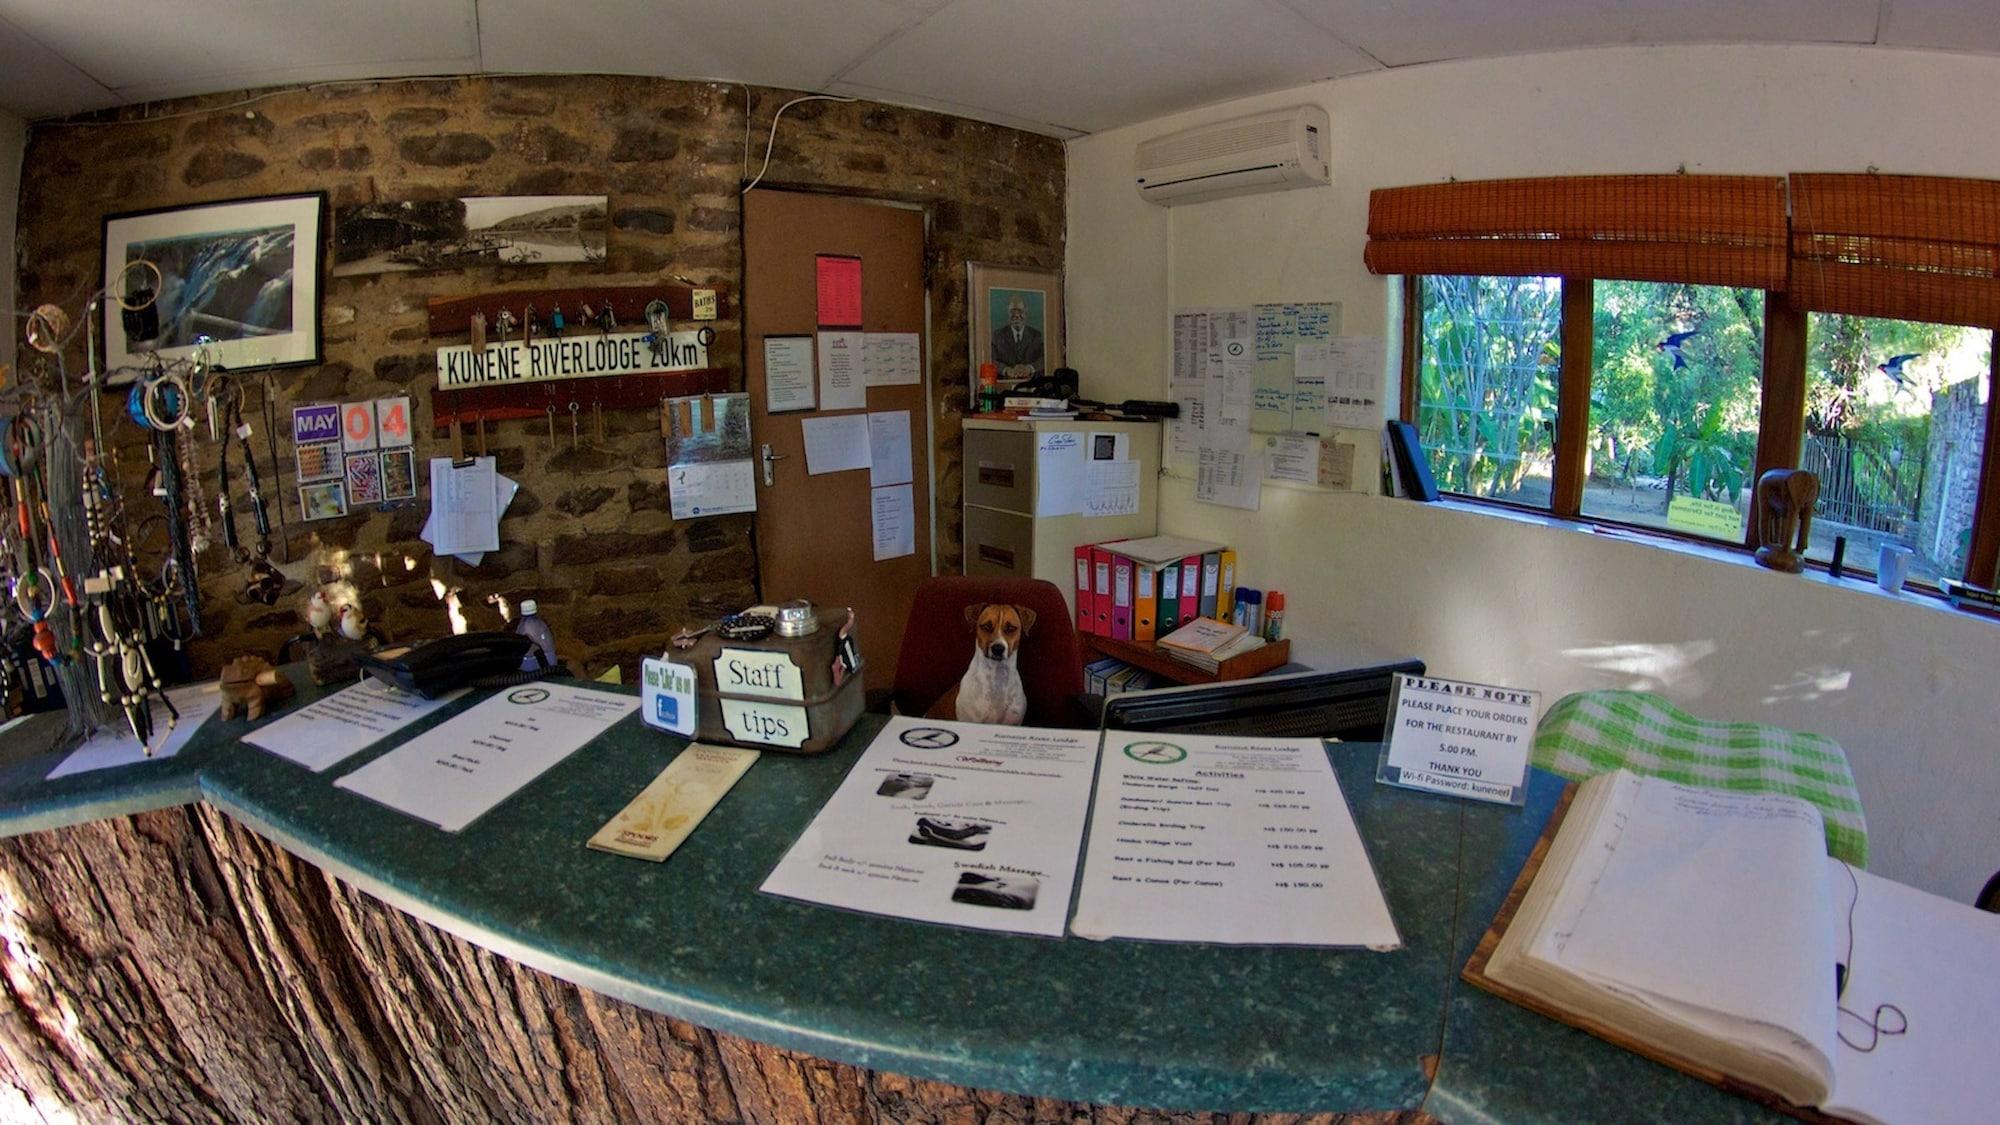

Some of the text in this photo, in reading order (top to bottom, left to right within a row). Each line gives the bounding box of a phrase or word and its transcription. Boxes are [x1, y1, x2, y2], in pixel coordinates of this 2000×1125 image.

[447, 346, 522, 385] KUNENE
[650, 341, 699, 369] 20km
[296, 412, 337, 434] MAY
[645, 663, 659, 688] Please
[676, 675, 683, 693] us
[683, 677, 692, 695] on
[728, 658, 786, 690] Staff
[1405, 677, 1532, 705] PLEASE NOTE
[1401, 698, 1528, 726] PLEASE PLACE YOUR ORDERS
[740, 709, 790, 741] tips
[1405, 718, 1518, 744] FOR THE RESTAURANT BY
[1439, 743, 1459, 754] 5.00
[1195, 770, 1245, 779] Activities
[1425, 772, 1470, 791] Password:
[1429, 761, 1482, 778] THANK YOU
[953, 861, 996, 871] Swedish
[1145, 857, 1174, 865] Fishing
